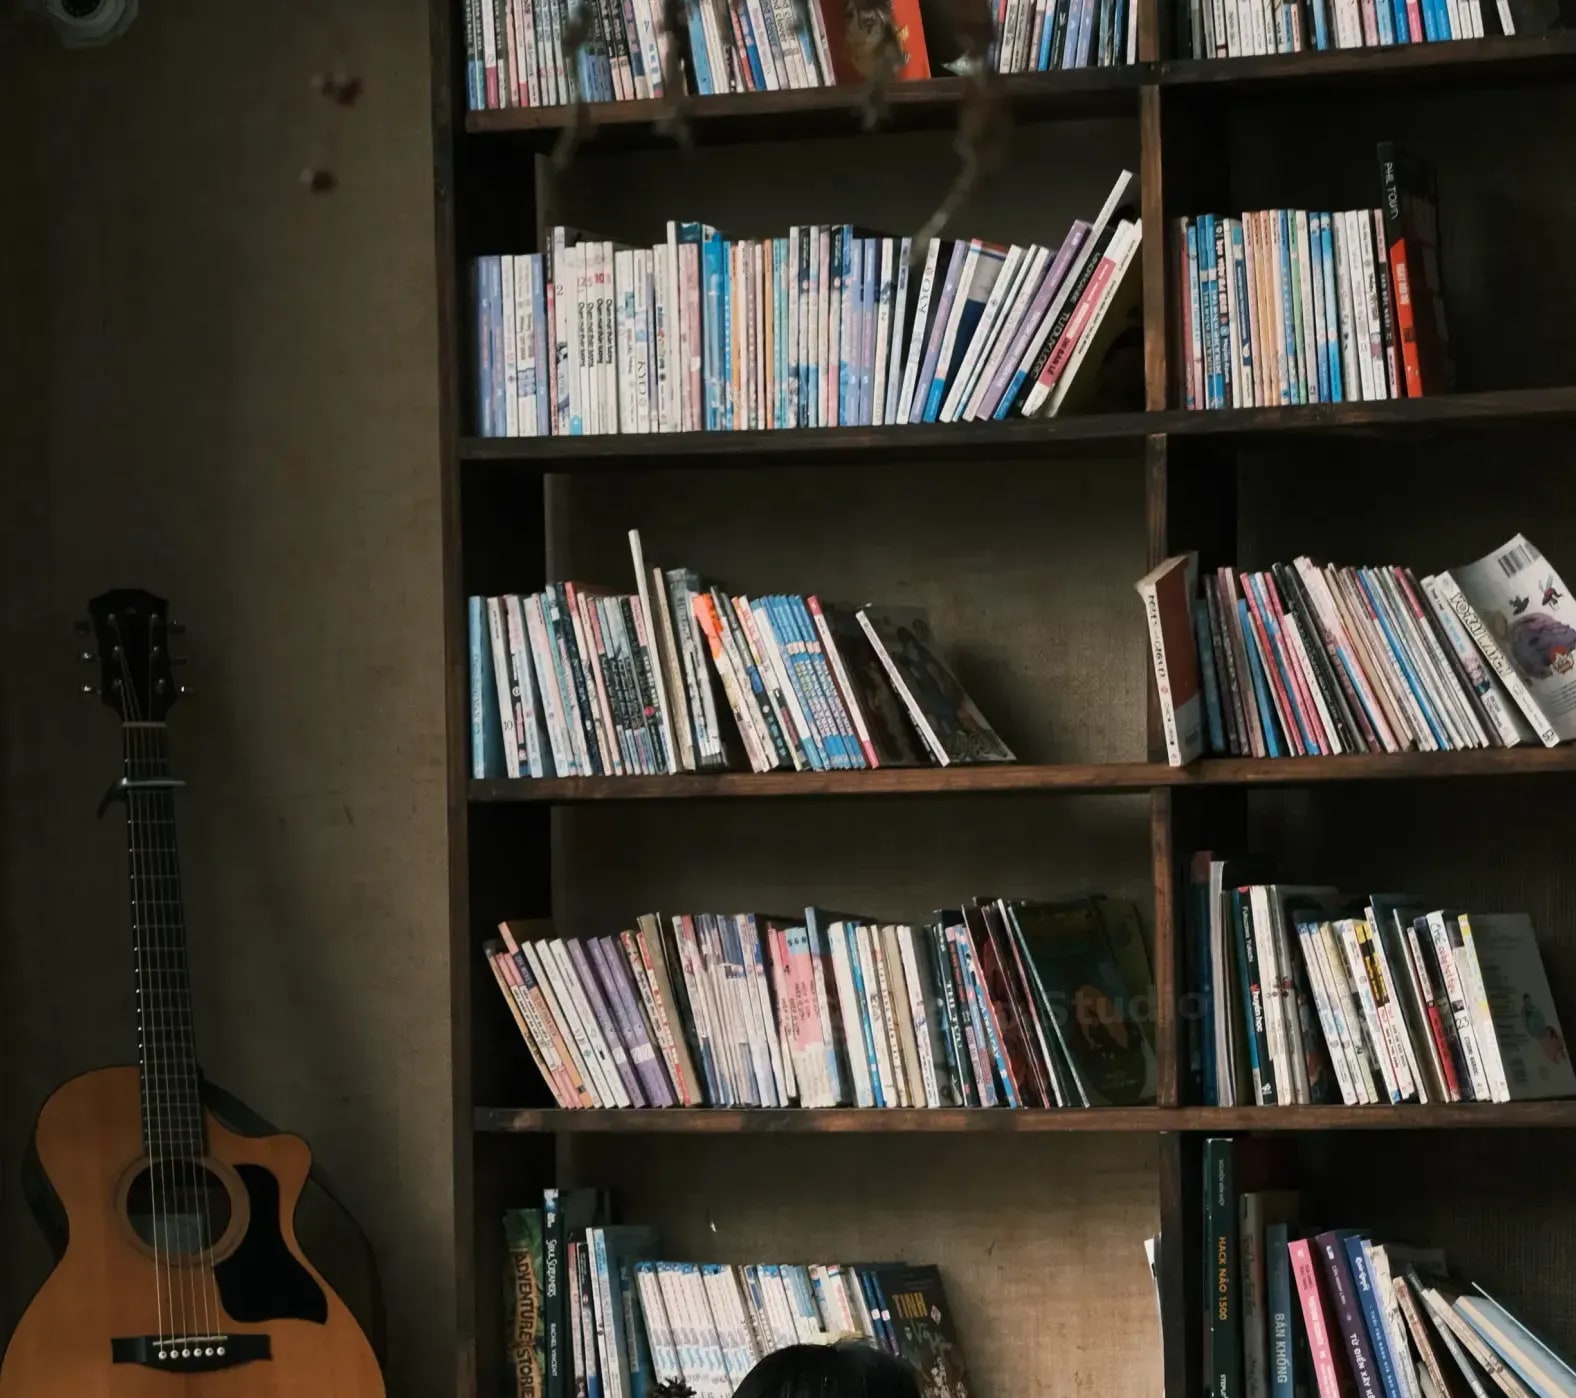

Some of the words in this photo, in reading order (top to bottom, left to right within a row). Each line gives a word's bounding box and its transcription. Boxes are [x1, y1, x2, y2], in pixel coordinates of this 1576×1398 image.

[1218, 1236, 1227, 1264] HACK
[514, 1253, 535, 1341] ADVENTURE
[1218, 1296, 1227, 1321] 1500
